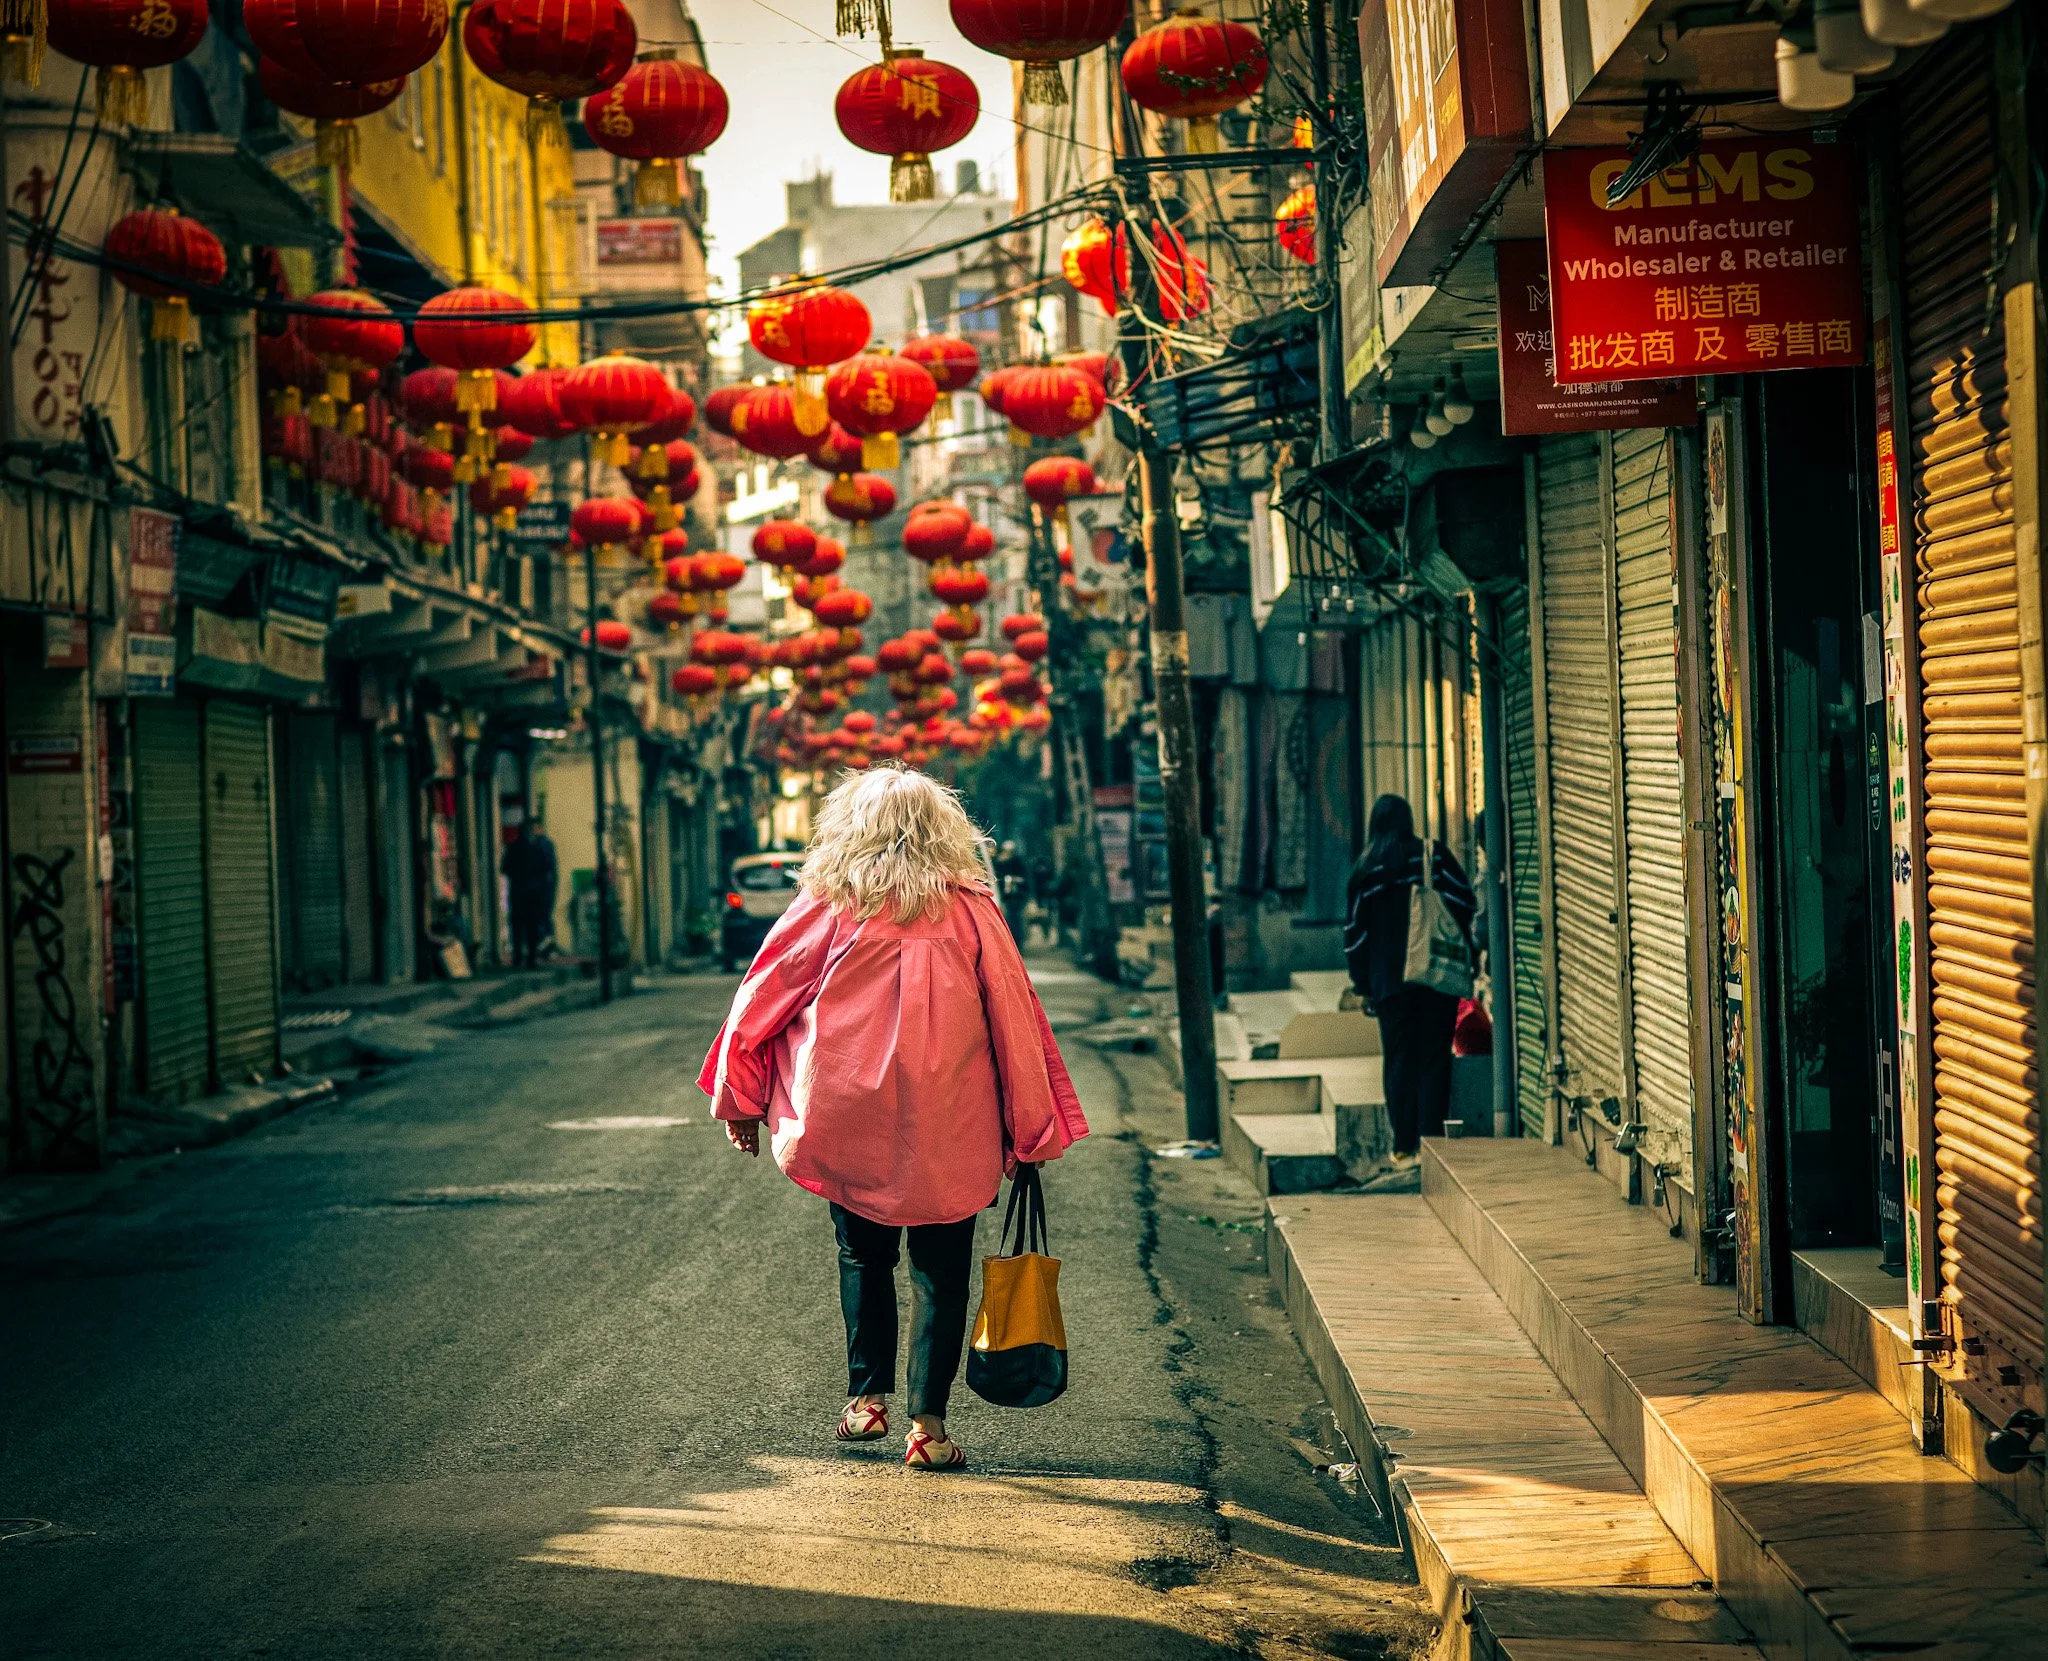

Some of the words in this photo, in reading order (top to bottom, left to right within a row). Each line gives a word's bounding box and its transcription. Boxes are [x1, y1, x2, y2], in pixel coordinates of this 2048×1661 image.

[1589, 148, 1815, 212] GEMS
[1614, 218, 1794, 247] Manufacturer
[1563, 251, 1711, 282] Wholesaler
[1719, 250, 1737, 272] &
[1745, 244, 1848, 271] Retailer
[14, 165, 71, 428] TTTOO
[1654, 282, 1761, 322] 制造商
[1569, 328, 1675, 371] 批发商
[1694, 327, 1728, 362] 及
[1745, 319, 1852, 359] 零售商
[1536, 398, 1659, 410] WWW.CASINOMAHJONGNEPAL.COM
